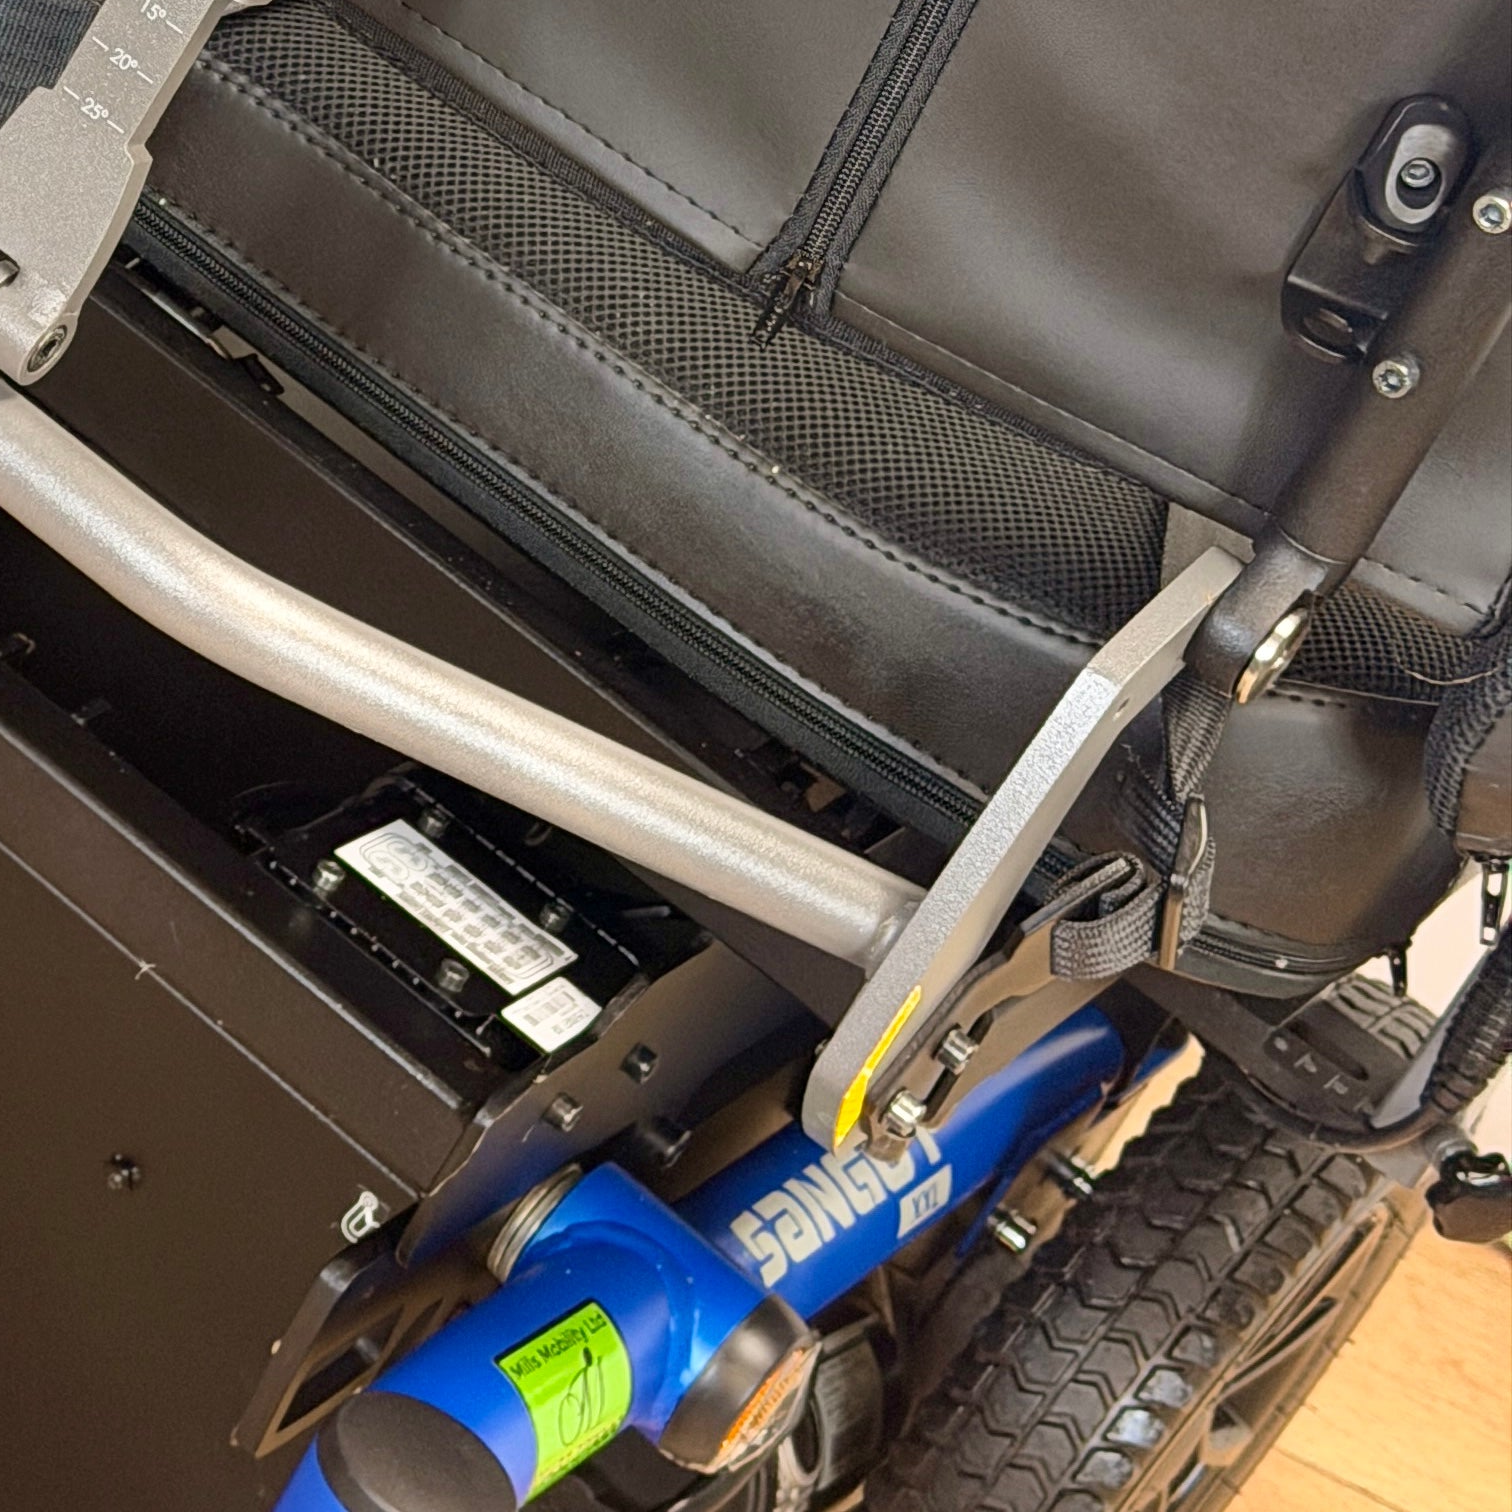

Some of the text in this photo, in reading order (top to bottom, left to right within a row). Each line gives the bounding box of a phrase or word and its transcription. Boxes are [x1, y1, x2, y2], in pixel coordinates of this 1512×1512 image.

[508, 1312, 607, 1379] Mills Mobility Ltd
